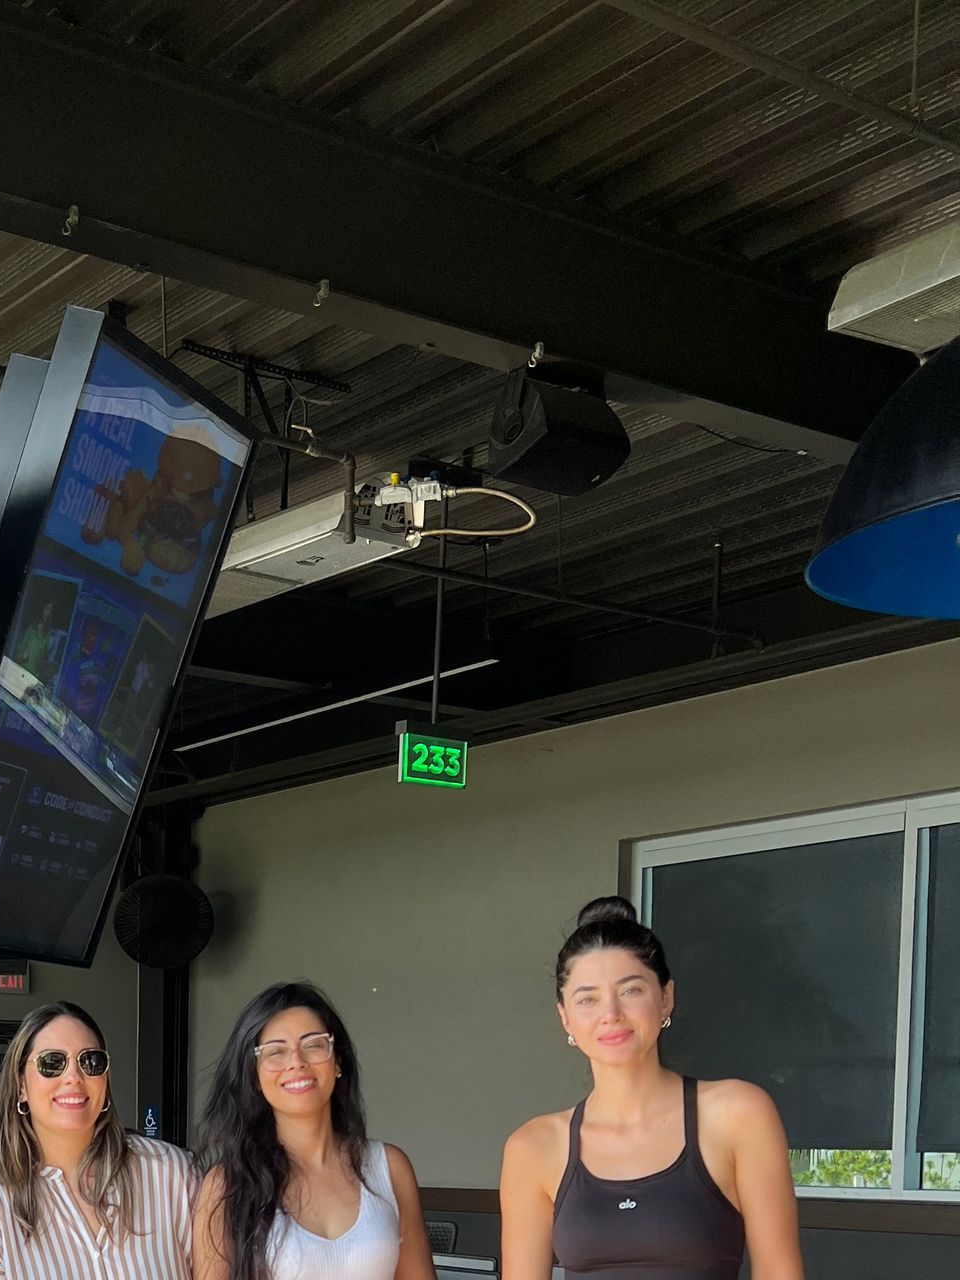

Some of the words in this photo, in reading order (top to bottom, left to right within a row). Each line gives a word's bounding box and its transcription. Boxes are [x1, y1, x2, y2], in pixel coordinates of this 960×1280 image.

[72, 433, 131, 496] SMOKE
[59, 477, 111, 534] SHOW
[411, 743, 461, 777] 233
[43, 791, 67, 811] CODE
[73, 801, 114, 822] CONDUCT
[619, 1198, 637, 1210] alo
